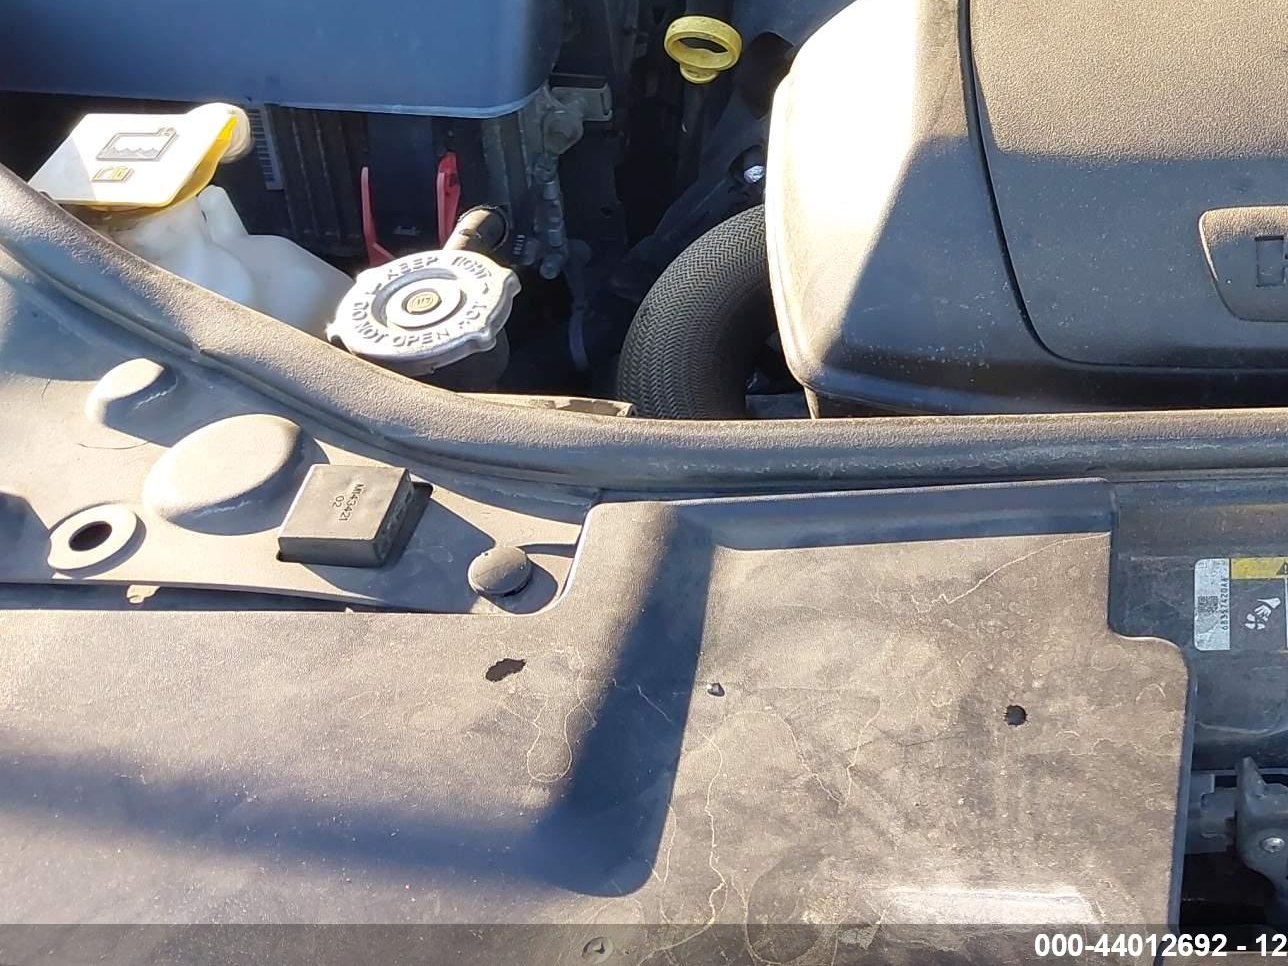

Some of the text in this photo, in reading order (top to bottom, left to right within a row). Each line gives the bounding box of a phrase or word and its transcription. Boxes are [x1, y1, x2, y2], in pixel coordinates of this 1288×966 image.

[387, 255, 439, 281] KEEP
[354, 319, 390, 344] NOT
[392, 328, 450, 348] OPEN
